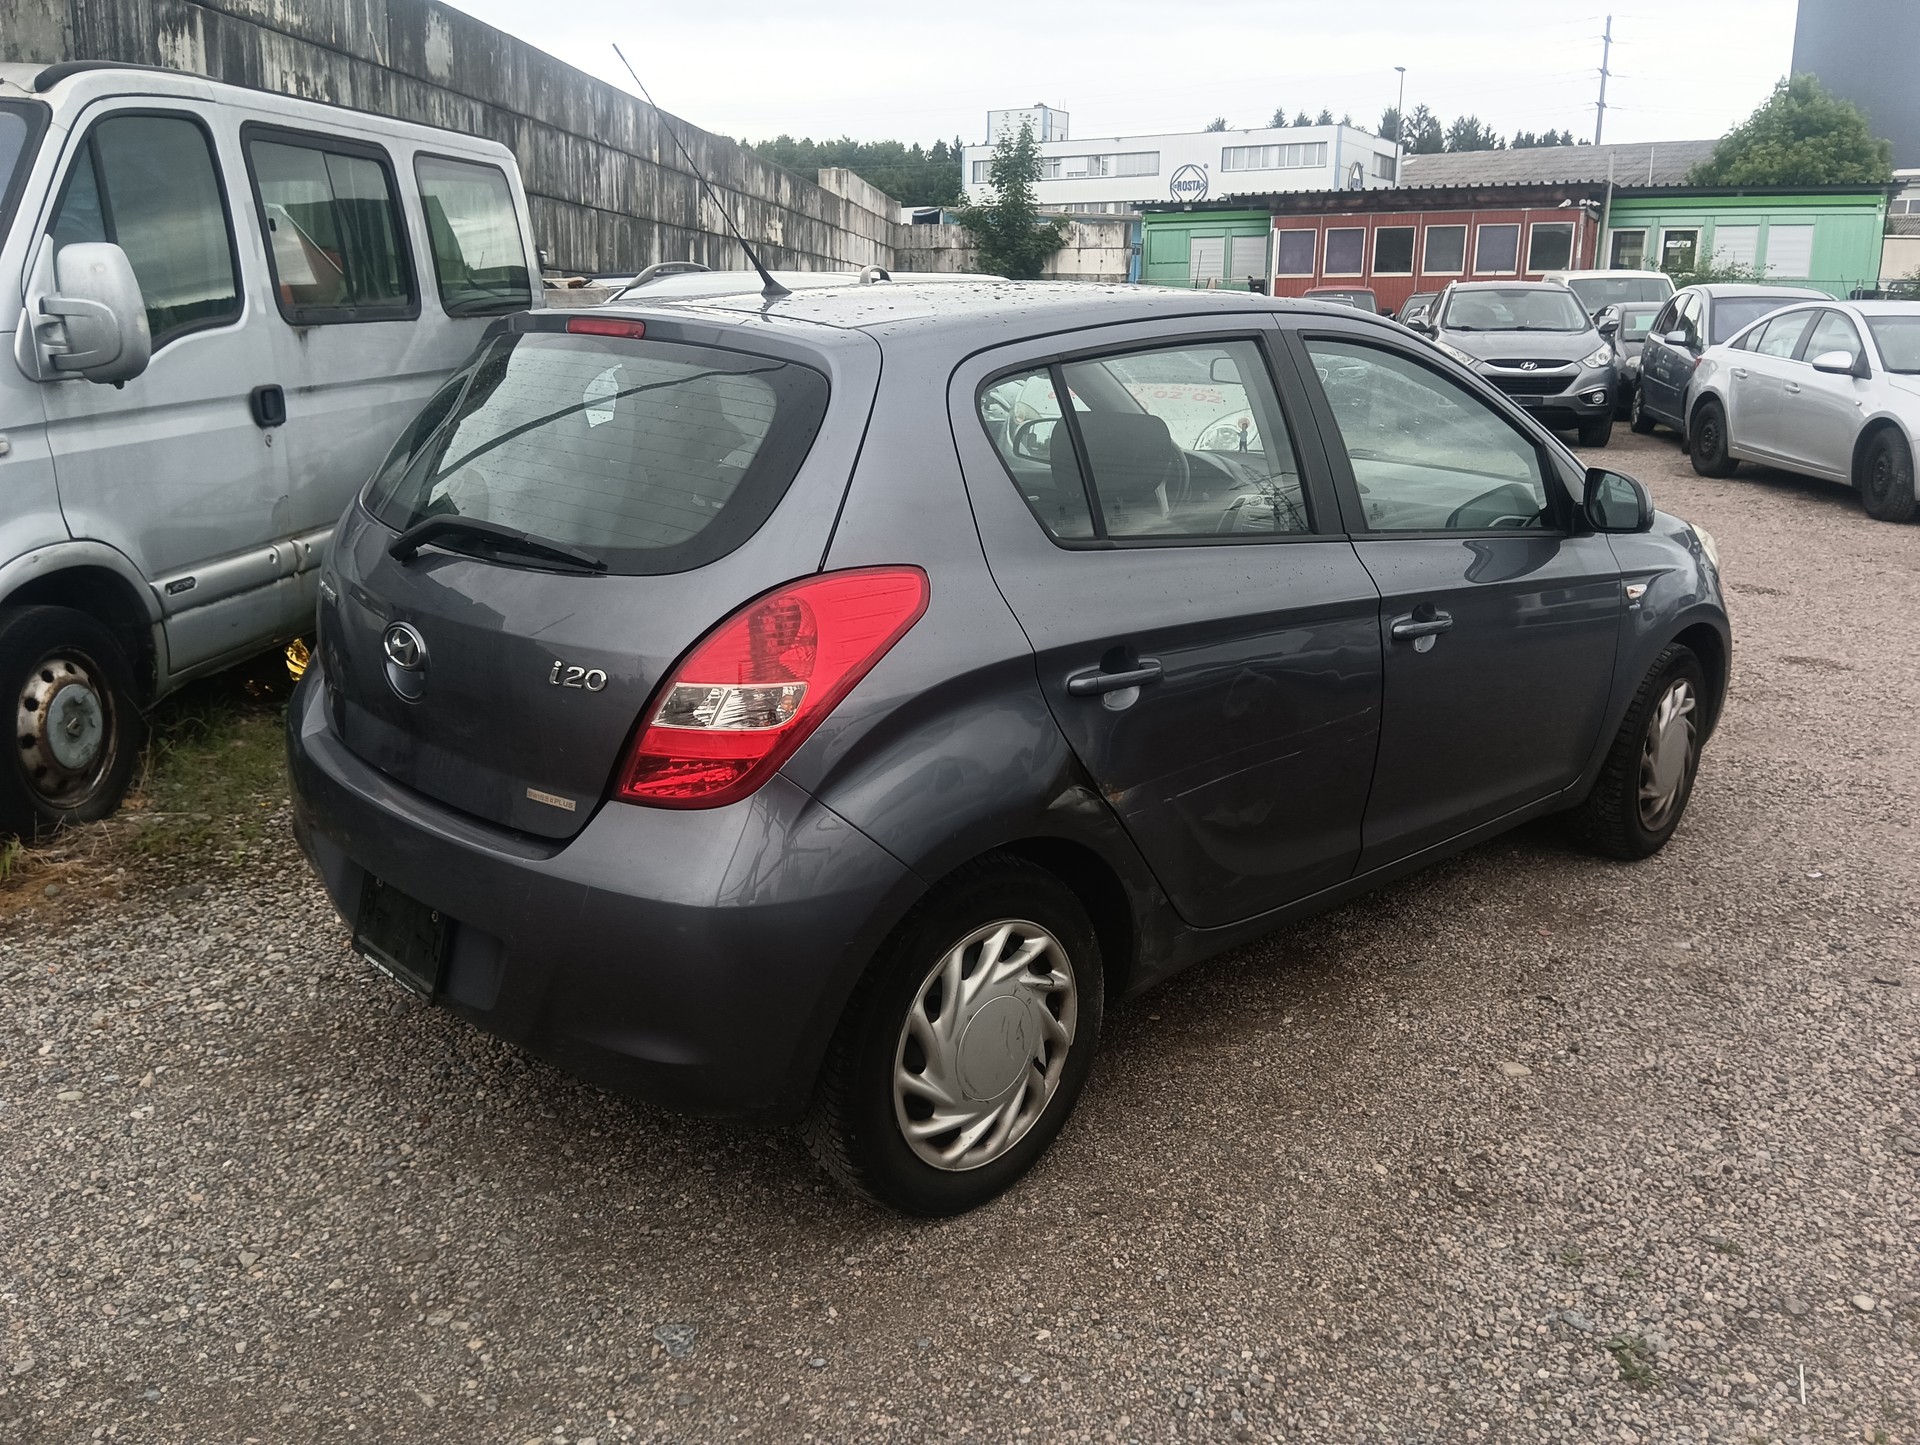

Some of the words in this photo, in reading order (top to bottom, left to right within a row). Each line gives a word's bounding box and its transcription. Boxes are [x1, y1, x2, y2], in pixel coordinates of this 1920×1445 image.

[1177, 180, 1201, 191] ROSTA
[549, 660, 607, 692] i20
[553, 797, 574, 809] PLUS
